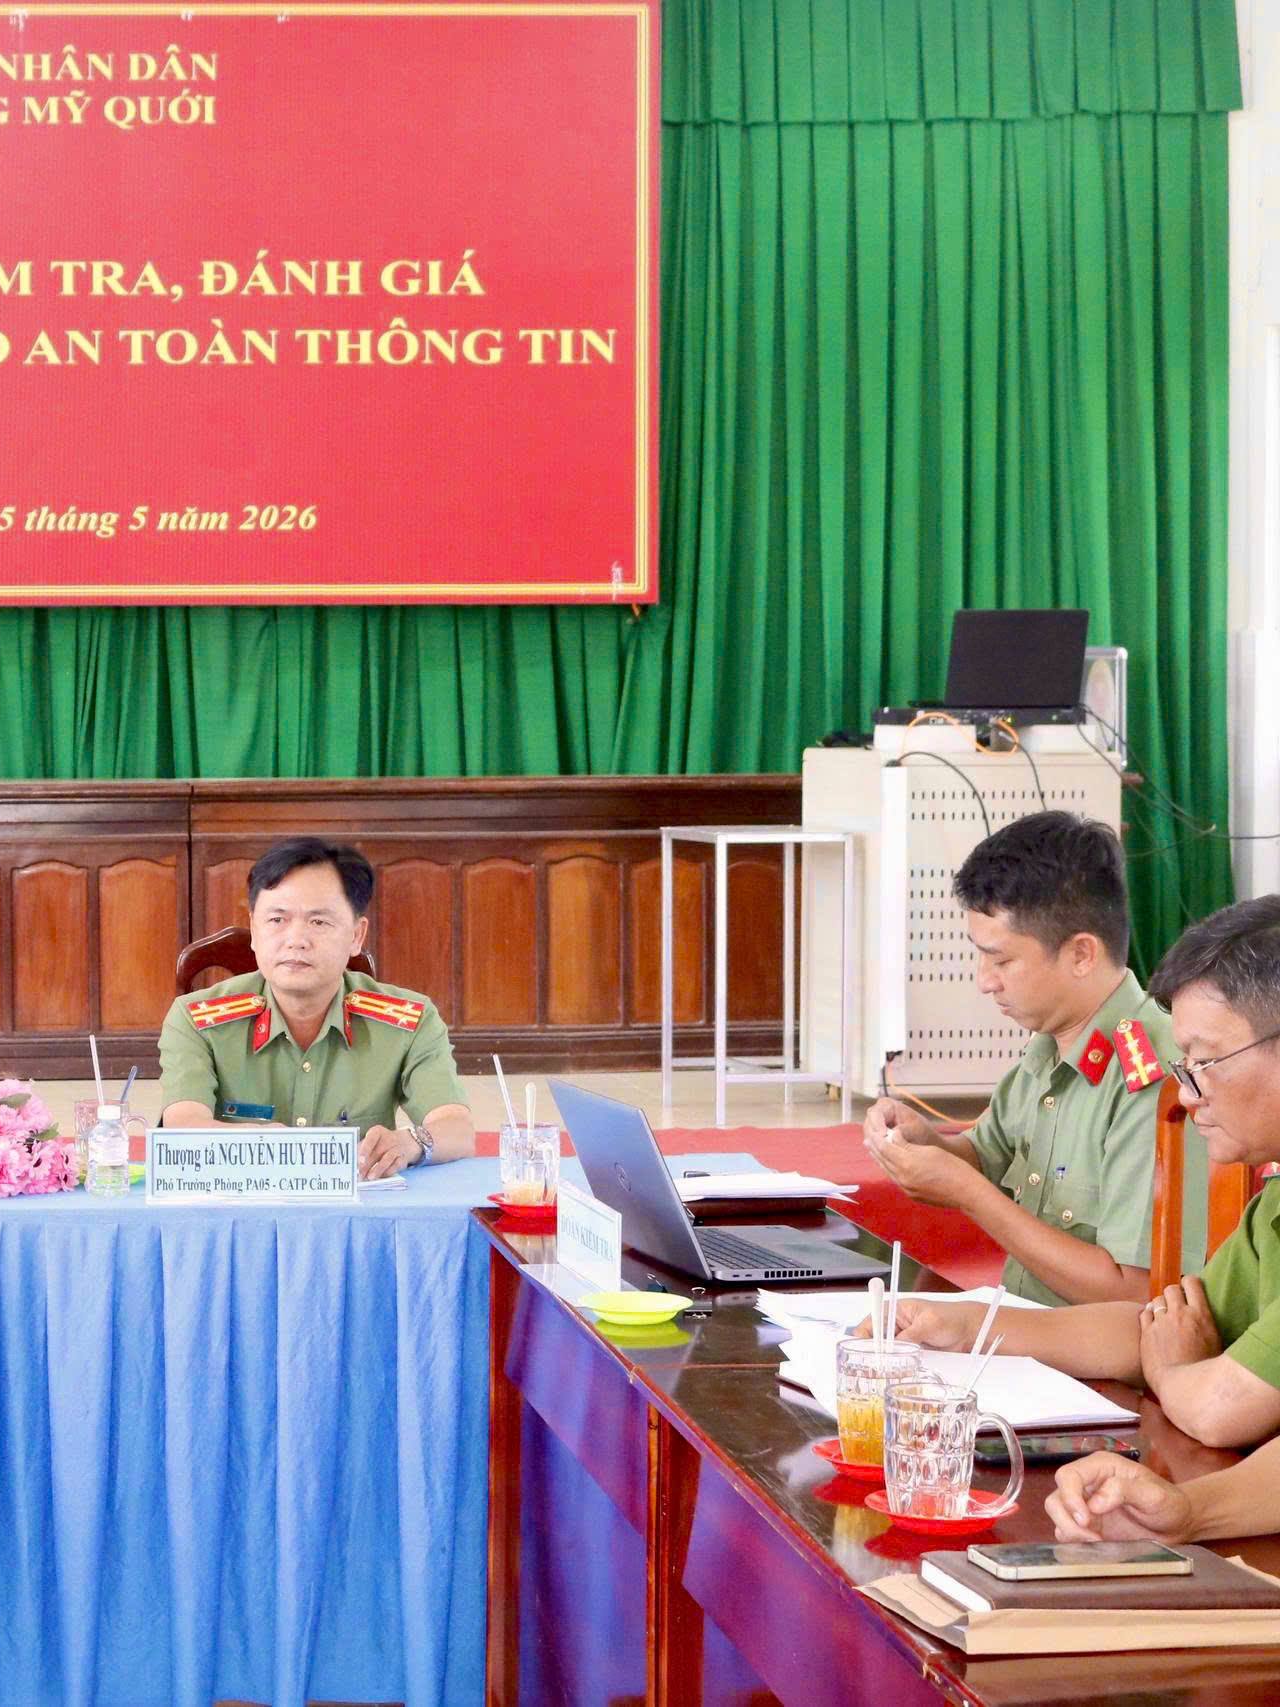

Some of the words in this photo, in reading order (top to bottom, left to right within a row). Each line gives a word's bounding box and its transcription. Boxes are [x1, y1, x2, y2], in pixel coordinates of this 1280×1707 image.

[128, 44, 218, 82] DÂN
[22, 90, 92, 125] MỸ
[103, 88, 217, 130] QUỚI
[49, 260, 184, 303] TRA,
[198, 249, 363, 296] ĐÁNH
[380, 249, 486, 297] GIÁ
[22, 329, 103, 366] AN
[118, 318, 279, 366] TOÀN
[294, 317, 504, 365] THÔNG
[518, 328, 616, 364] TIN
[24, 506, 120, 538] tháng
[128, 506, 149, 531] 5
[156, 507, 230, 531] năm
[238, 505, 318, 531] 2026
[156, 1143, 201, 1172] Thượng
[204, 1142, 215, 1165] tá
[218, 1135, 275, 1166] NGUYỄN
[278, 1142, 308, 1166] HUY
[309, 1135, 350, 1165] THÊM
[156, 1178, 174, 1191] Phó
[213, 1177, 244, 1193] Phòng
[245, 1178, 270, 1191] PA05
[278, 1178, 308, 1191] CATP
[309, 1174, 328, 1191] Cần
[331, 1178, 351, 1191] Thơ
